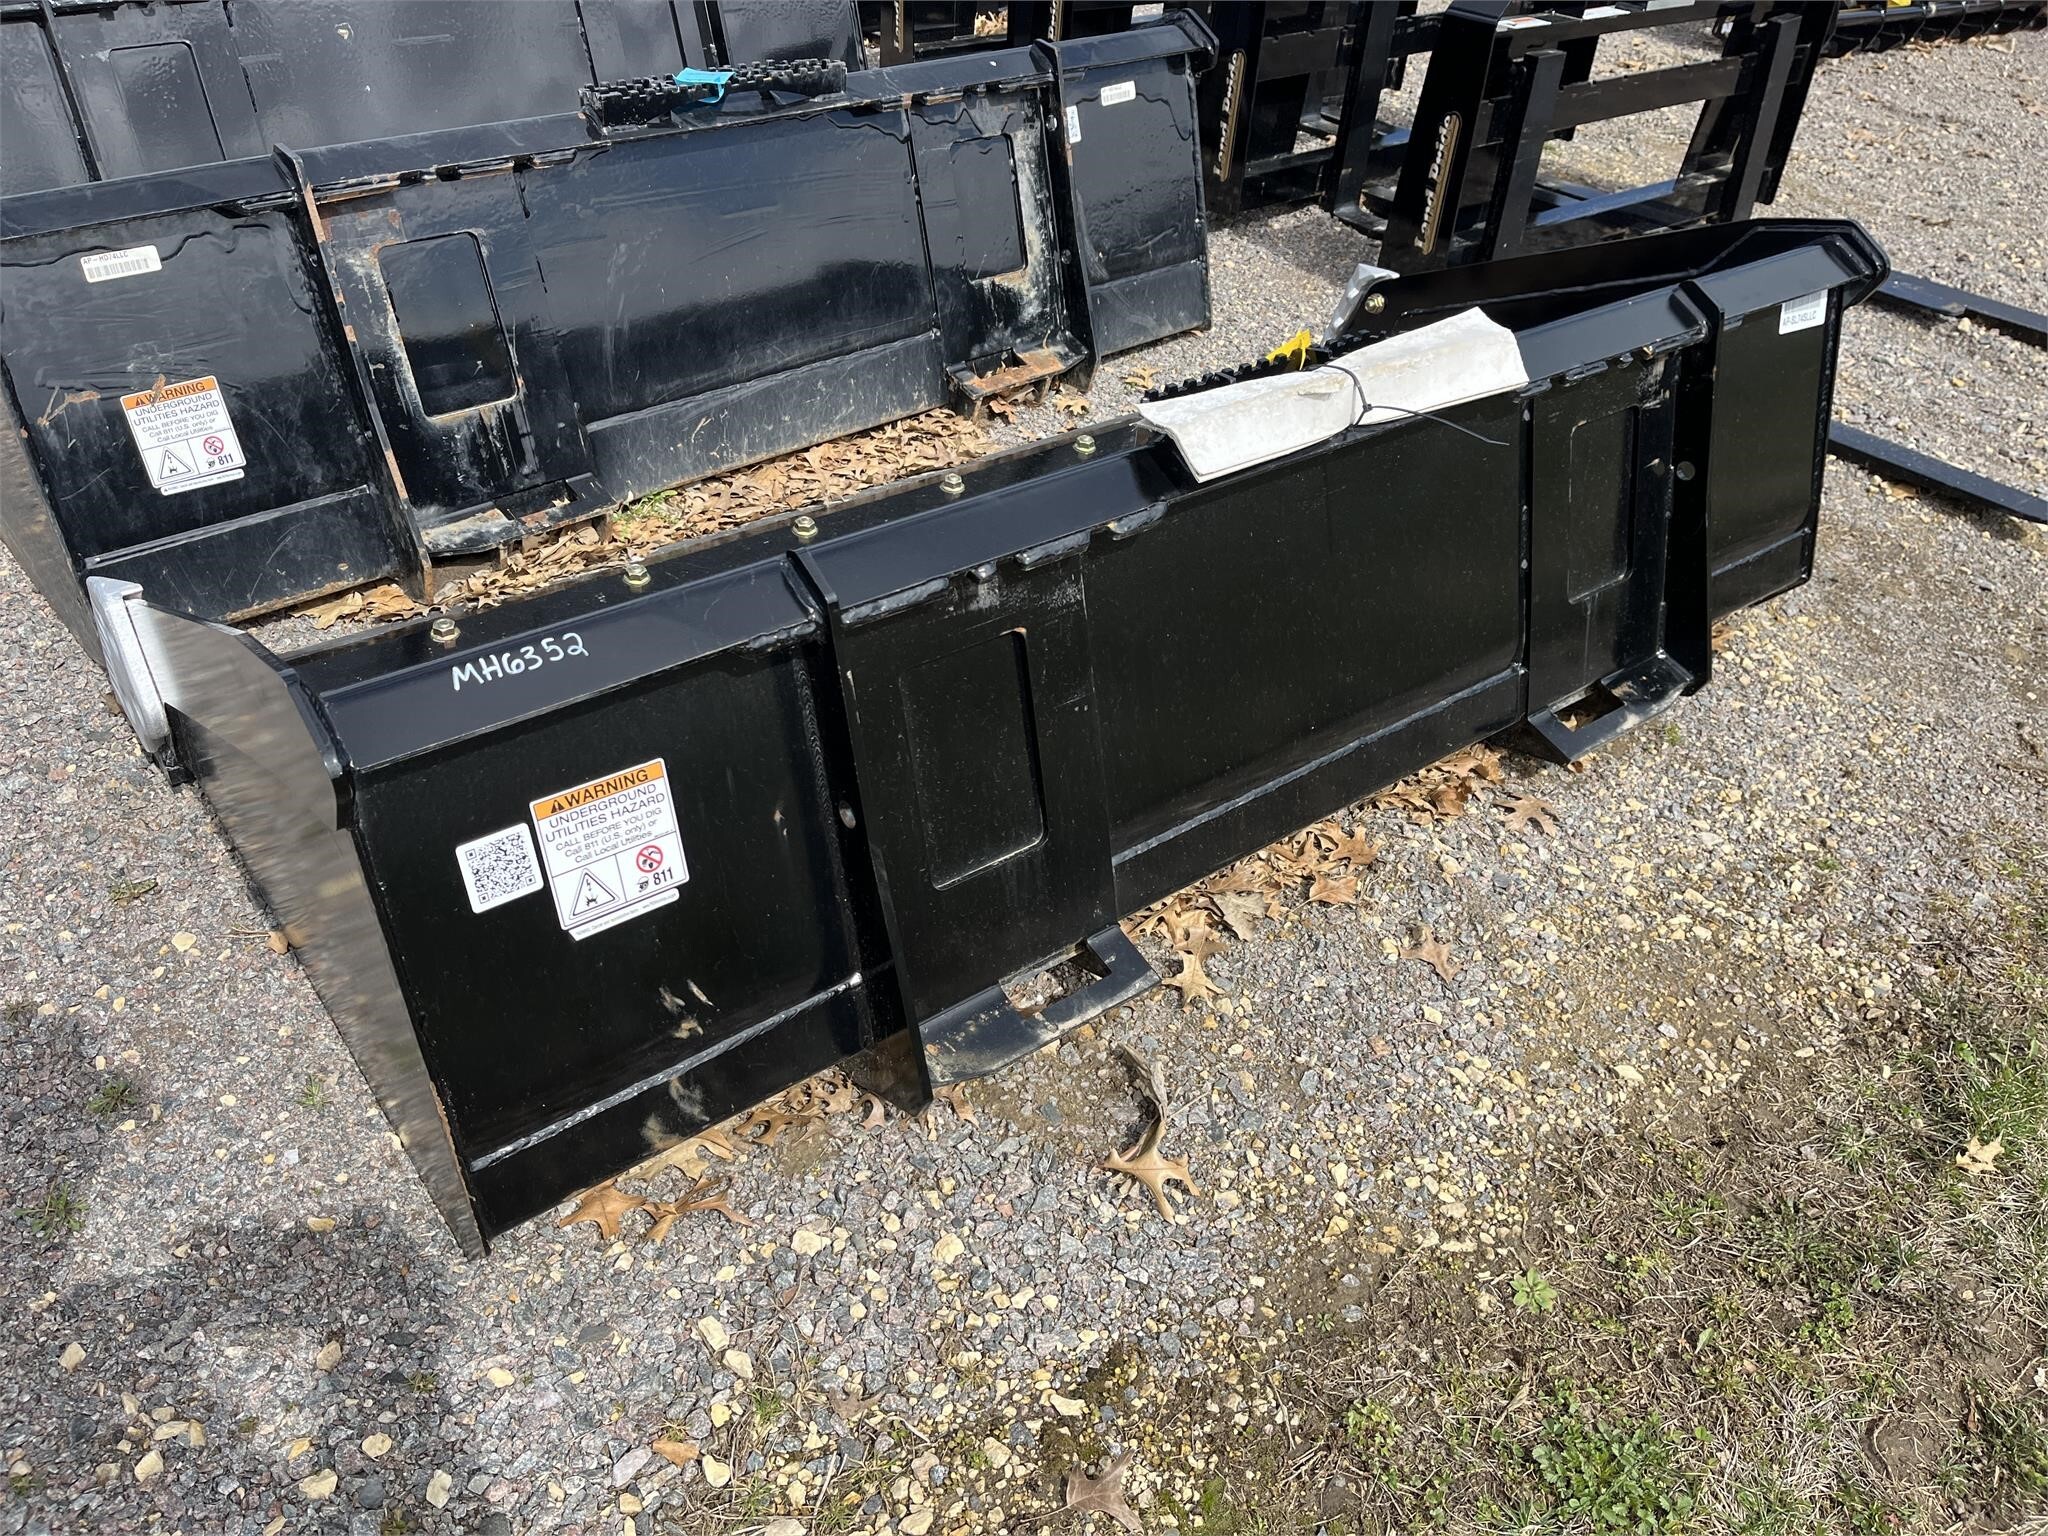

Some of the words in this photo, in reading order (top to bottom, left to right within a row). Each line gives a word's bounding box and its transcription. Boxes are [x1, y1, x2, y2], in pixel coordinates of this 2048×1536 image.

[1213, 120, 1228, 176] Land
[1221, 52, 1238, 112] Pride
[1413, 186, 1434, 248] Land
[1428, 115, 1451, 180] Pride
[133, 409, 178, 427] UTILITIES
[180, 399, 220, 415] HAZARD
[134, 392, 213, 417] UNDERGROUND
[141, 424, 161, 433] CALL
[161, 417, 190, 428] BEFORE
[190, 412, 205, 422] YOU
[206, 408, 219, 418] DIG
[217, 453, 234, 466] 811
[451, 632, 590, 692] MH6352
[548, 783, 657, 829] UNDERGROUND
[564, 769, 649, 808] WARNING
[545, 812, 608, 843] UTILITIES
[610, 792, 666, 820] HAZARD
[555, 835, 580, 851] CALL
[583, 822, 622, 841] BEFORE
[624, 814, 644, 826] YOU
[645, 807, 663, 819] DIG
[564, 844, 583, 858] Call
[584, 838, 599, 850] 811
[601, 830, 621, 846] (U.S.
[625, 820, 647, 838] only)
[648, 818, 658, 827] or
[574, 850, 593, 864] Call
[594, 839, 620, 857] Local
[620, 830, 653, 847] Utilities
[652, 866, 674, 886] 811
